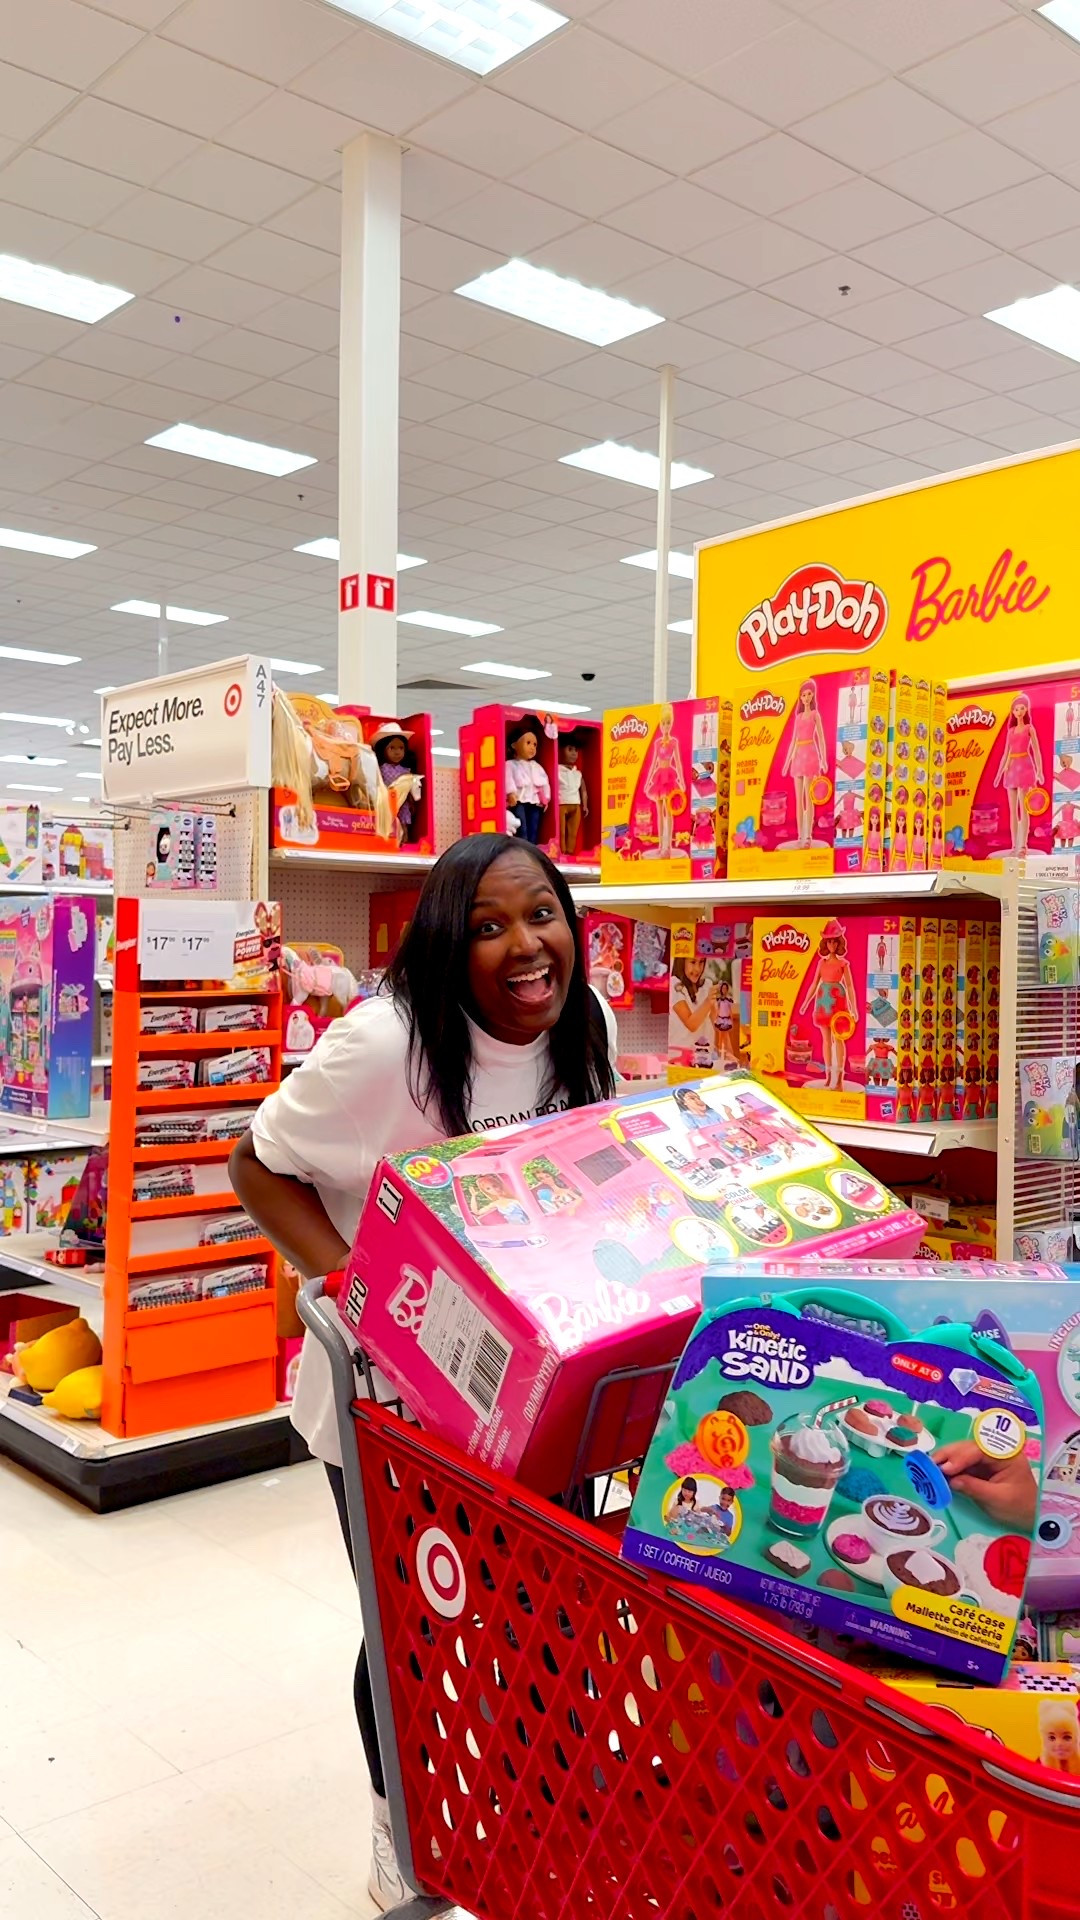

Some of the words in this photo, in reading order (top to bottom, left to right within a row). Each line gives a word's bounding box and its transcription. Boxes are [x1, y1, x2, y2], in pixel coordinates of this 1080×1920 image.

[906, 548, 1050, 641] Barbie
[740, 580, 879, 659] Play-Doh
[109, 702, 158, 737] Expect
[161, 697, 204, 722] More.
[740, 694, 785, 719] Play-Doh
[611, 718, 648, 741] Play-Doh
[946, 708, 996, 732] Play-Doh
[109, 737, 133, 766] Pay
[137, 733, 174, 758] Less.
[738, 726, 775, 751] Barbie
[609, 746, 640, 769] Barbie
[945, 739, 984, 763] Barbie
[884, 920, 897, 932] 5+
[762, 930, 810, 950] Play-Doh
[760, 958, 799, 982] Barbie
[151, 1011, 177, 1022] Energizer
[472, 1110, 531, 1132] ORDAN
[405, 1157, 440, 1178] 60+
[345, 1275, 367, 1328] FIFO
[537, 1281, 651, 1347] Barbie
[753, 1322, 771, 1331] One
[759, 1329, 781, 1341] Only!
[728, 1329, 807, 1361] Kinetic
[892, 1355, 918, 1372] ONLY
[919, 1366, 932, 1376] AT
[995, 1414, 1011, 1433] 10
[638, 1542, 643, 1554] 1
[643, 1543, 661, 1560] SET
[664, 1550, 701, 1574] COFFRET
[704, 1565, 733, 1585] JUEGO
[763, 1591, 780, 1607] 1.75
[780, 1596, 788, 1609] lb
[905, 1602, 951, 1624] Mallette
[952, 1617, 1003, 1641] Cafétéria
[949, 1603, 977, 1620] Café
[978, 1611, 1006, 1630] Case
[869, 1618, 913, 1641] WARNING:
[961, 1630, 969, 1639] de
[966, 1659, 980, 1671] 5+
